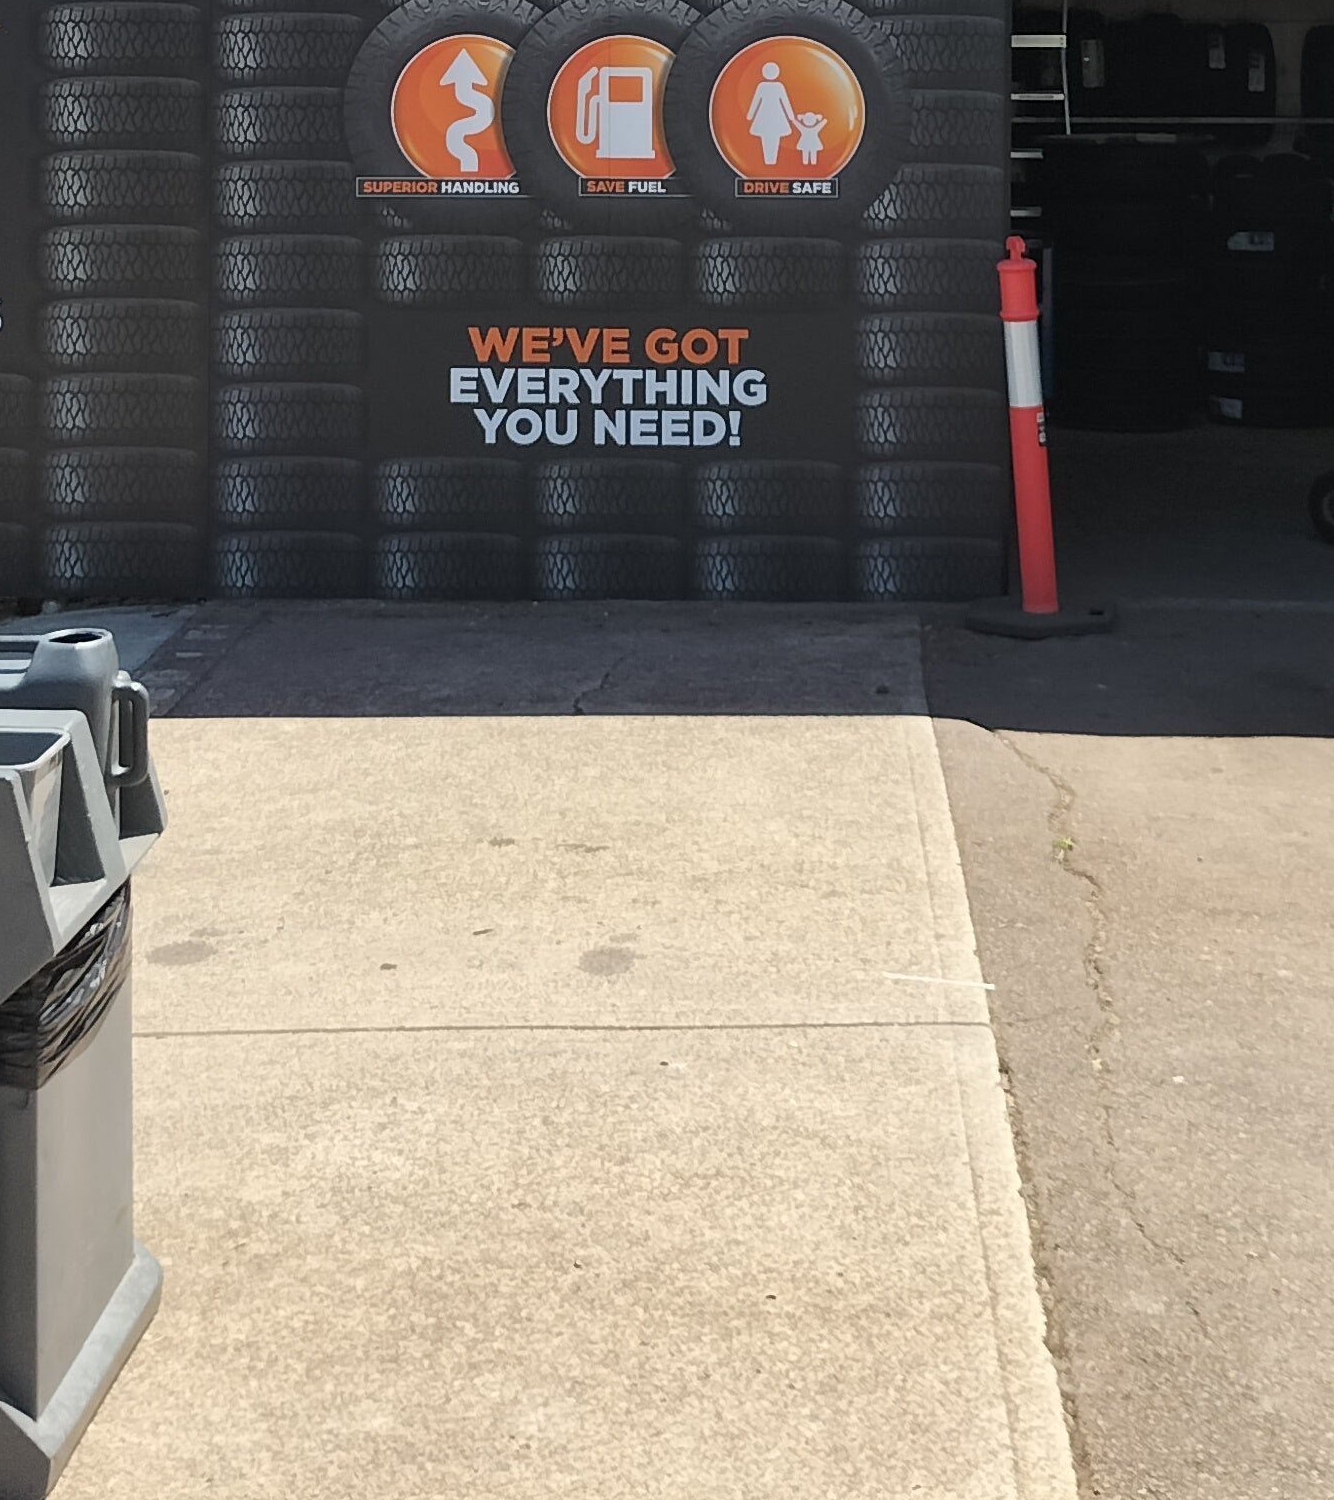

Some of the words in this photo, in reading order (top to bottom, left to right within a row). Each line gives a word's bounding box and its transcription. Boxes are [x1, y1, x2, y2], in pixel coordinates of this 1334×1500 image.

[362, 180, 438, 194] SUPERIOR
[440, 180, 520, 194] HANDLING
[586, 180, 625, 193] SAVE
[628, 180, 667, 193] FUEL
[743, 181, 789, 194] DRIVE
[792, 181, 832, 194] SAFE
[468, 329, 630, 364] WE'VE
[645, 328, 749, 364] GOT
[450, 368, 768, 406] EVERYTHING
[474, 409, 578, 446] YOU
[594, 409, 741, 446] NEED!
